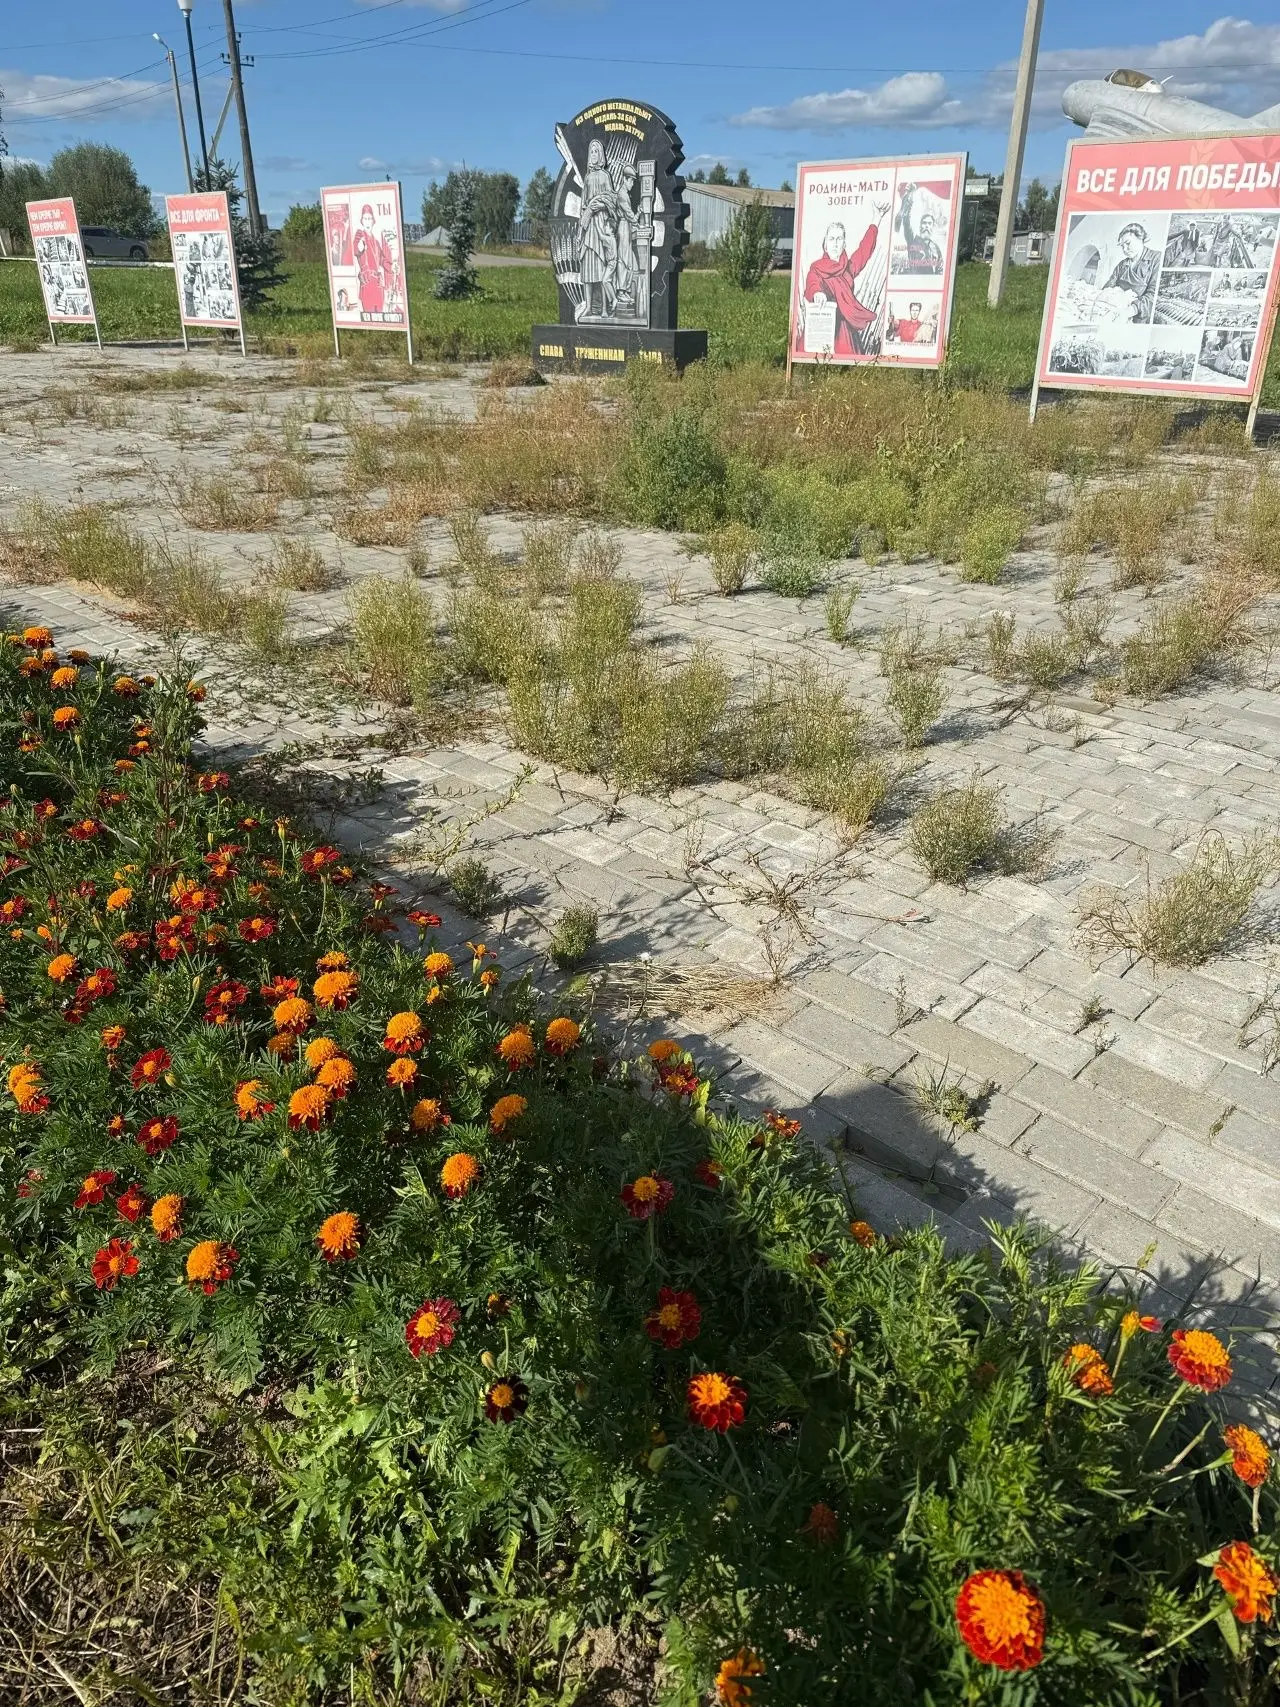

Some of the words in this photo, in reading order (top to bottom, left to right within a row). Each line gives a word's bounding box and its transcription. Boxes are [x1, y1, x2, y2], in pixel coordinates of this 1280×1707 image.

[575, 115, 584, 126] ИЗ
[584, 104, 607, 120] ОДНОГО
[607, 102, 634, 113] МЕТАЛЛА
[634, 106, 653, 121] ЛЬЮТ
[594, 112, 617, 125] МЕДАЛЬ
[617, 112, 625, 121] ЗА
[605, 122, 625, 132] МЕДАЛЬ
[625, 124, 632, 133] ЗА
[632, 128, 645, 141] ТРУД
[809, 180, 889, 194] РОДИНА-МАТЬ
[1076, 168, 1117, 193] ВСЕ
[1119, 166, 1171, 196] ДЛЯ
[1175, 161, 1280, 193] ПОБЕДЫ
[376, 202, 392, 216] ТЫ
[827, 195, 864, 206] ЗОВЕТ!
[169, 210, 182, 224] ВСЕ
[181, 209, 195, 225] ДЛЯ
[194, 207, 220, 224] ФРОНТА
[540, 345, 563, 357] СЛАВА
[575, 347, 624, 361] ТРУЖЕНИКАМ
[639, 351, 662, 363] ТЫЛА
